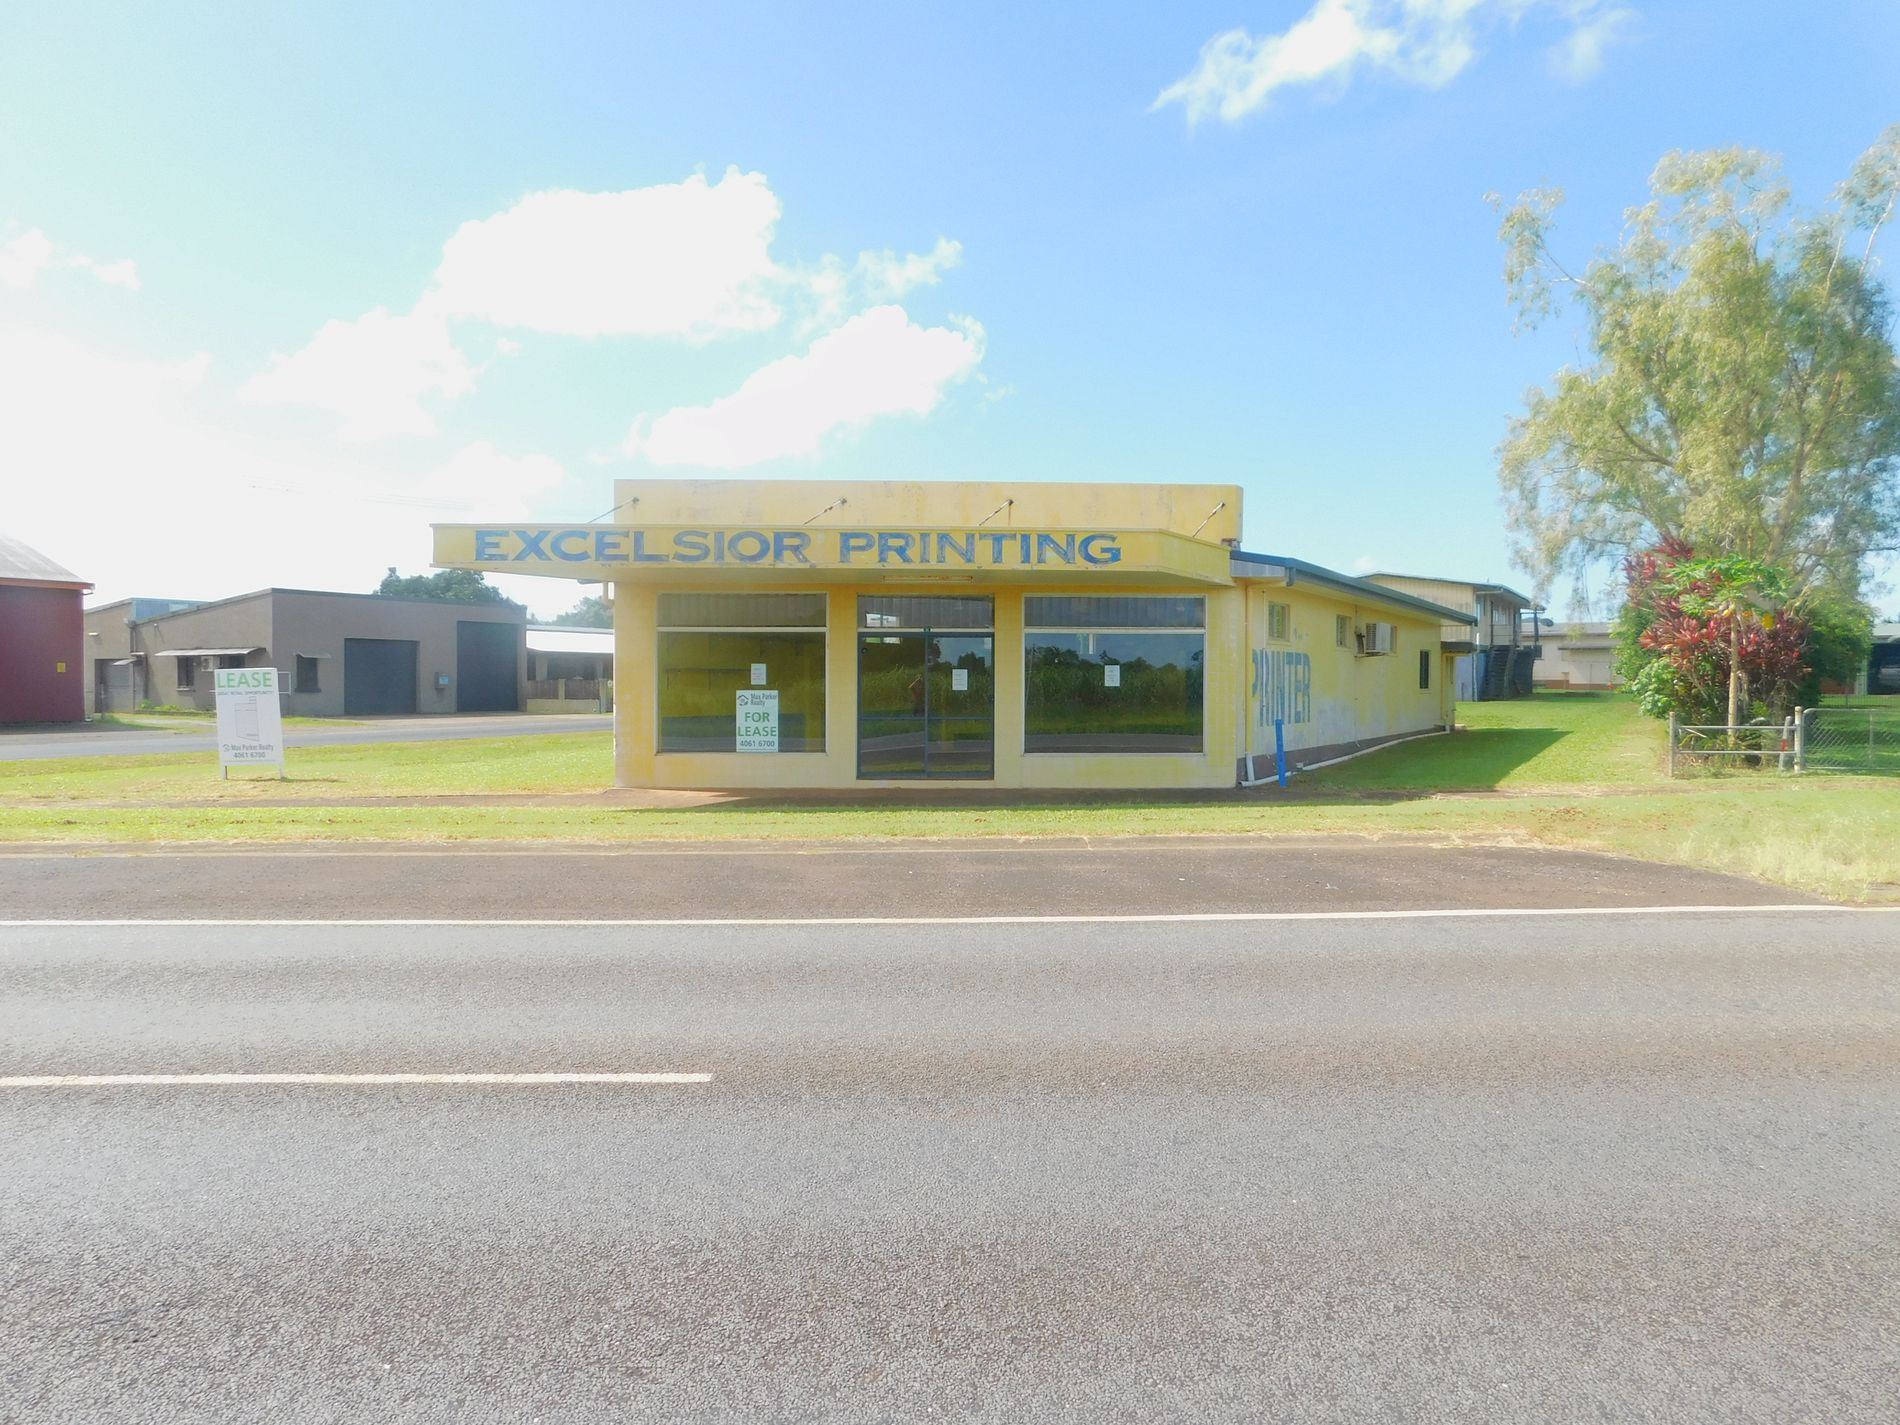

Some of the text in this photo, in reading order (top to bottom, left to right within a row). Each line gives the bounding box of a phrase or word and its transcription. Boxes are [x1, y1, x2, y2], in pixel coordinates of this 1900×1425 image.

[475, 529, 1122, 565] EXCELSIOR PRINTING
[217, 671, 273, 688] LEASE
[744, 712, 770, 722] FOR
[738, 726, 777, 736] LEASE
[259, 743, 274, 752] Realty
